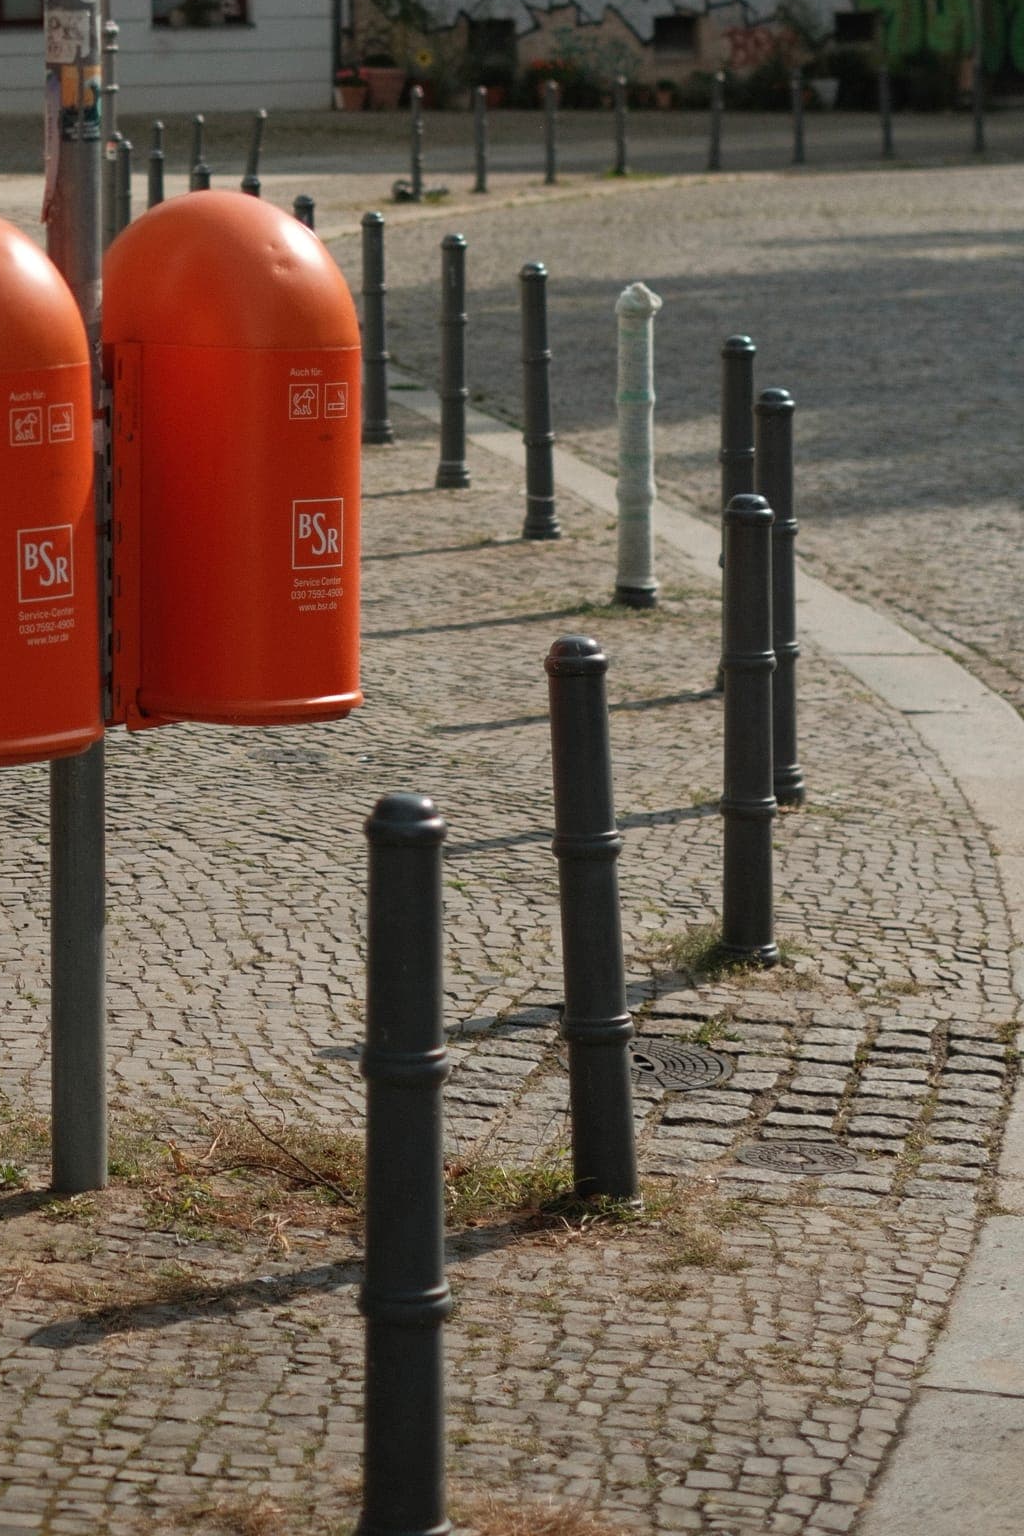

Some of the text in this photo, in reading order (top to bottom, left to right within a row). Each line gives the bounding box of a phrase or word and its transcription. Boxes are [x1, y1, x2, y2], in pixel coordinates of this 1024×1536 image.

[289, 367, 310, 377] Auch
[9, 391, 32, 402] Auch
[298, 512, 339, 556] BSR
[24, 541, 69, 586] BSR
